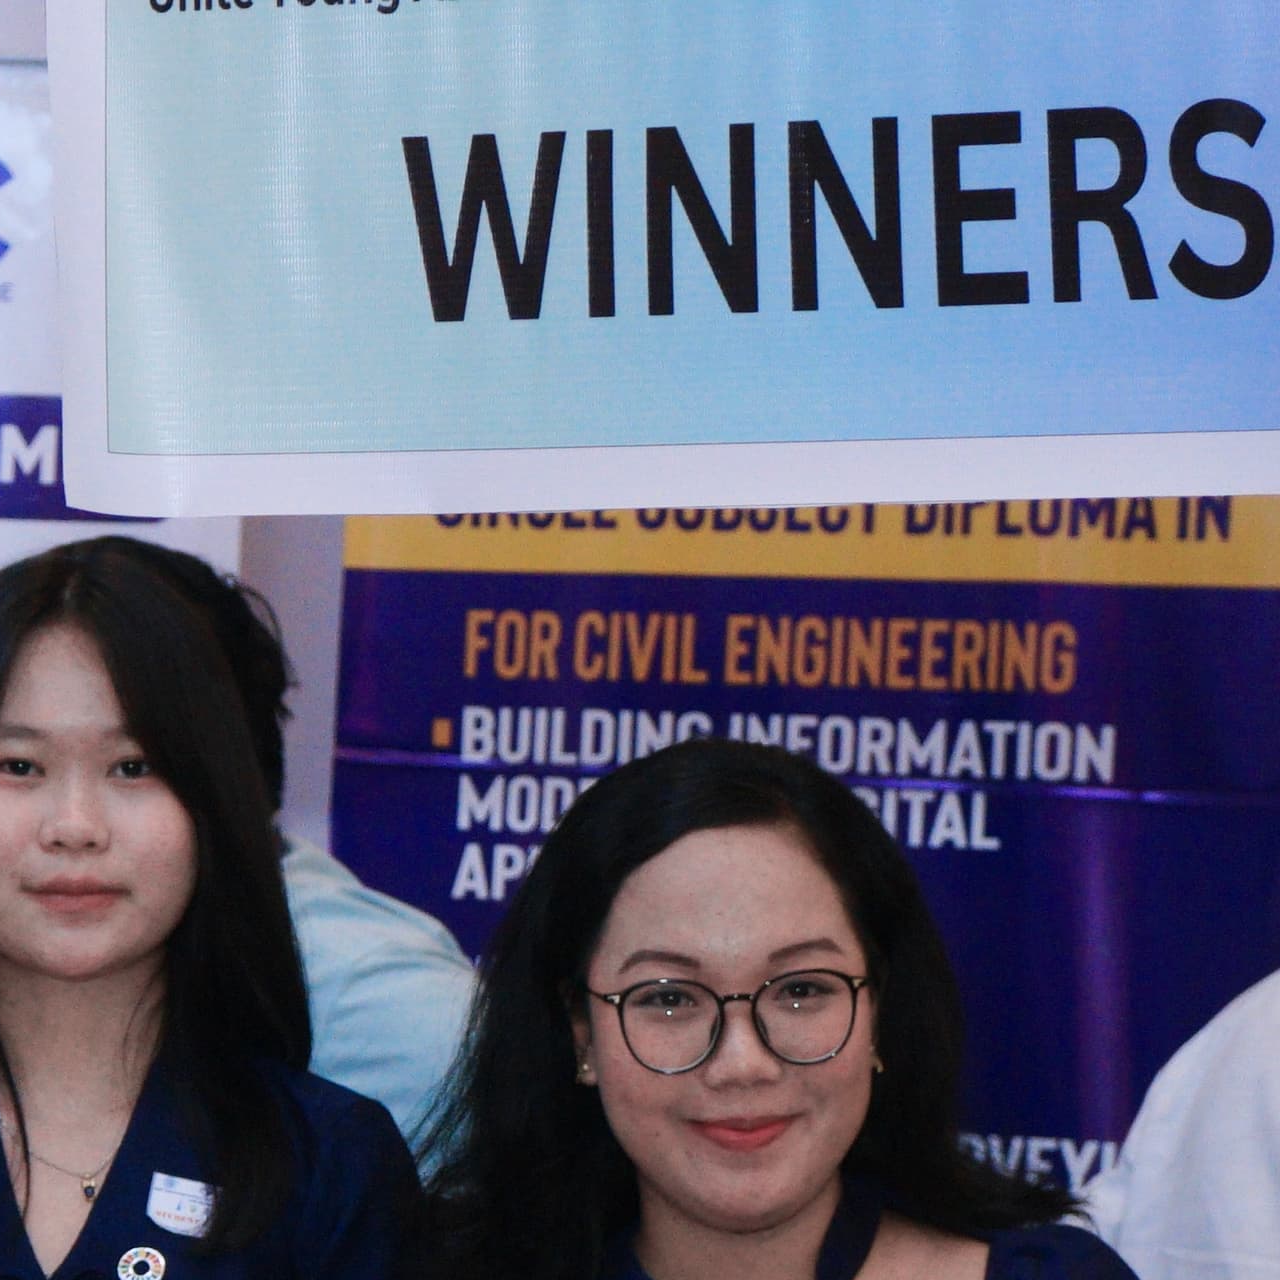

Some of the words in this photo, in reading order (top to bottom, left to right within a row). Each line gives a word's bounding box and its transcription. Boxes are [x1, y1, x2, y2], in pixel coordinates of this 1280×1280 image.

[402, 98, 1275, 323] WINNERS
[463, 609, 559, 679] FOR
[572, 612, 708, 685] CIVIL
[723, 614, 1077, 694] ENGINEERING
[456, 776, 598, 833] MOD
[450, 842, 543, 901] AP
